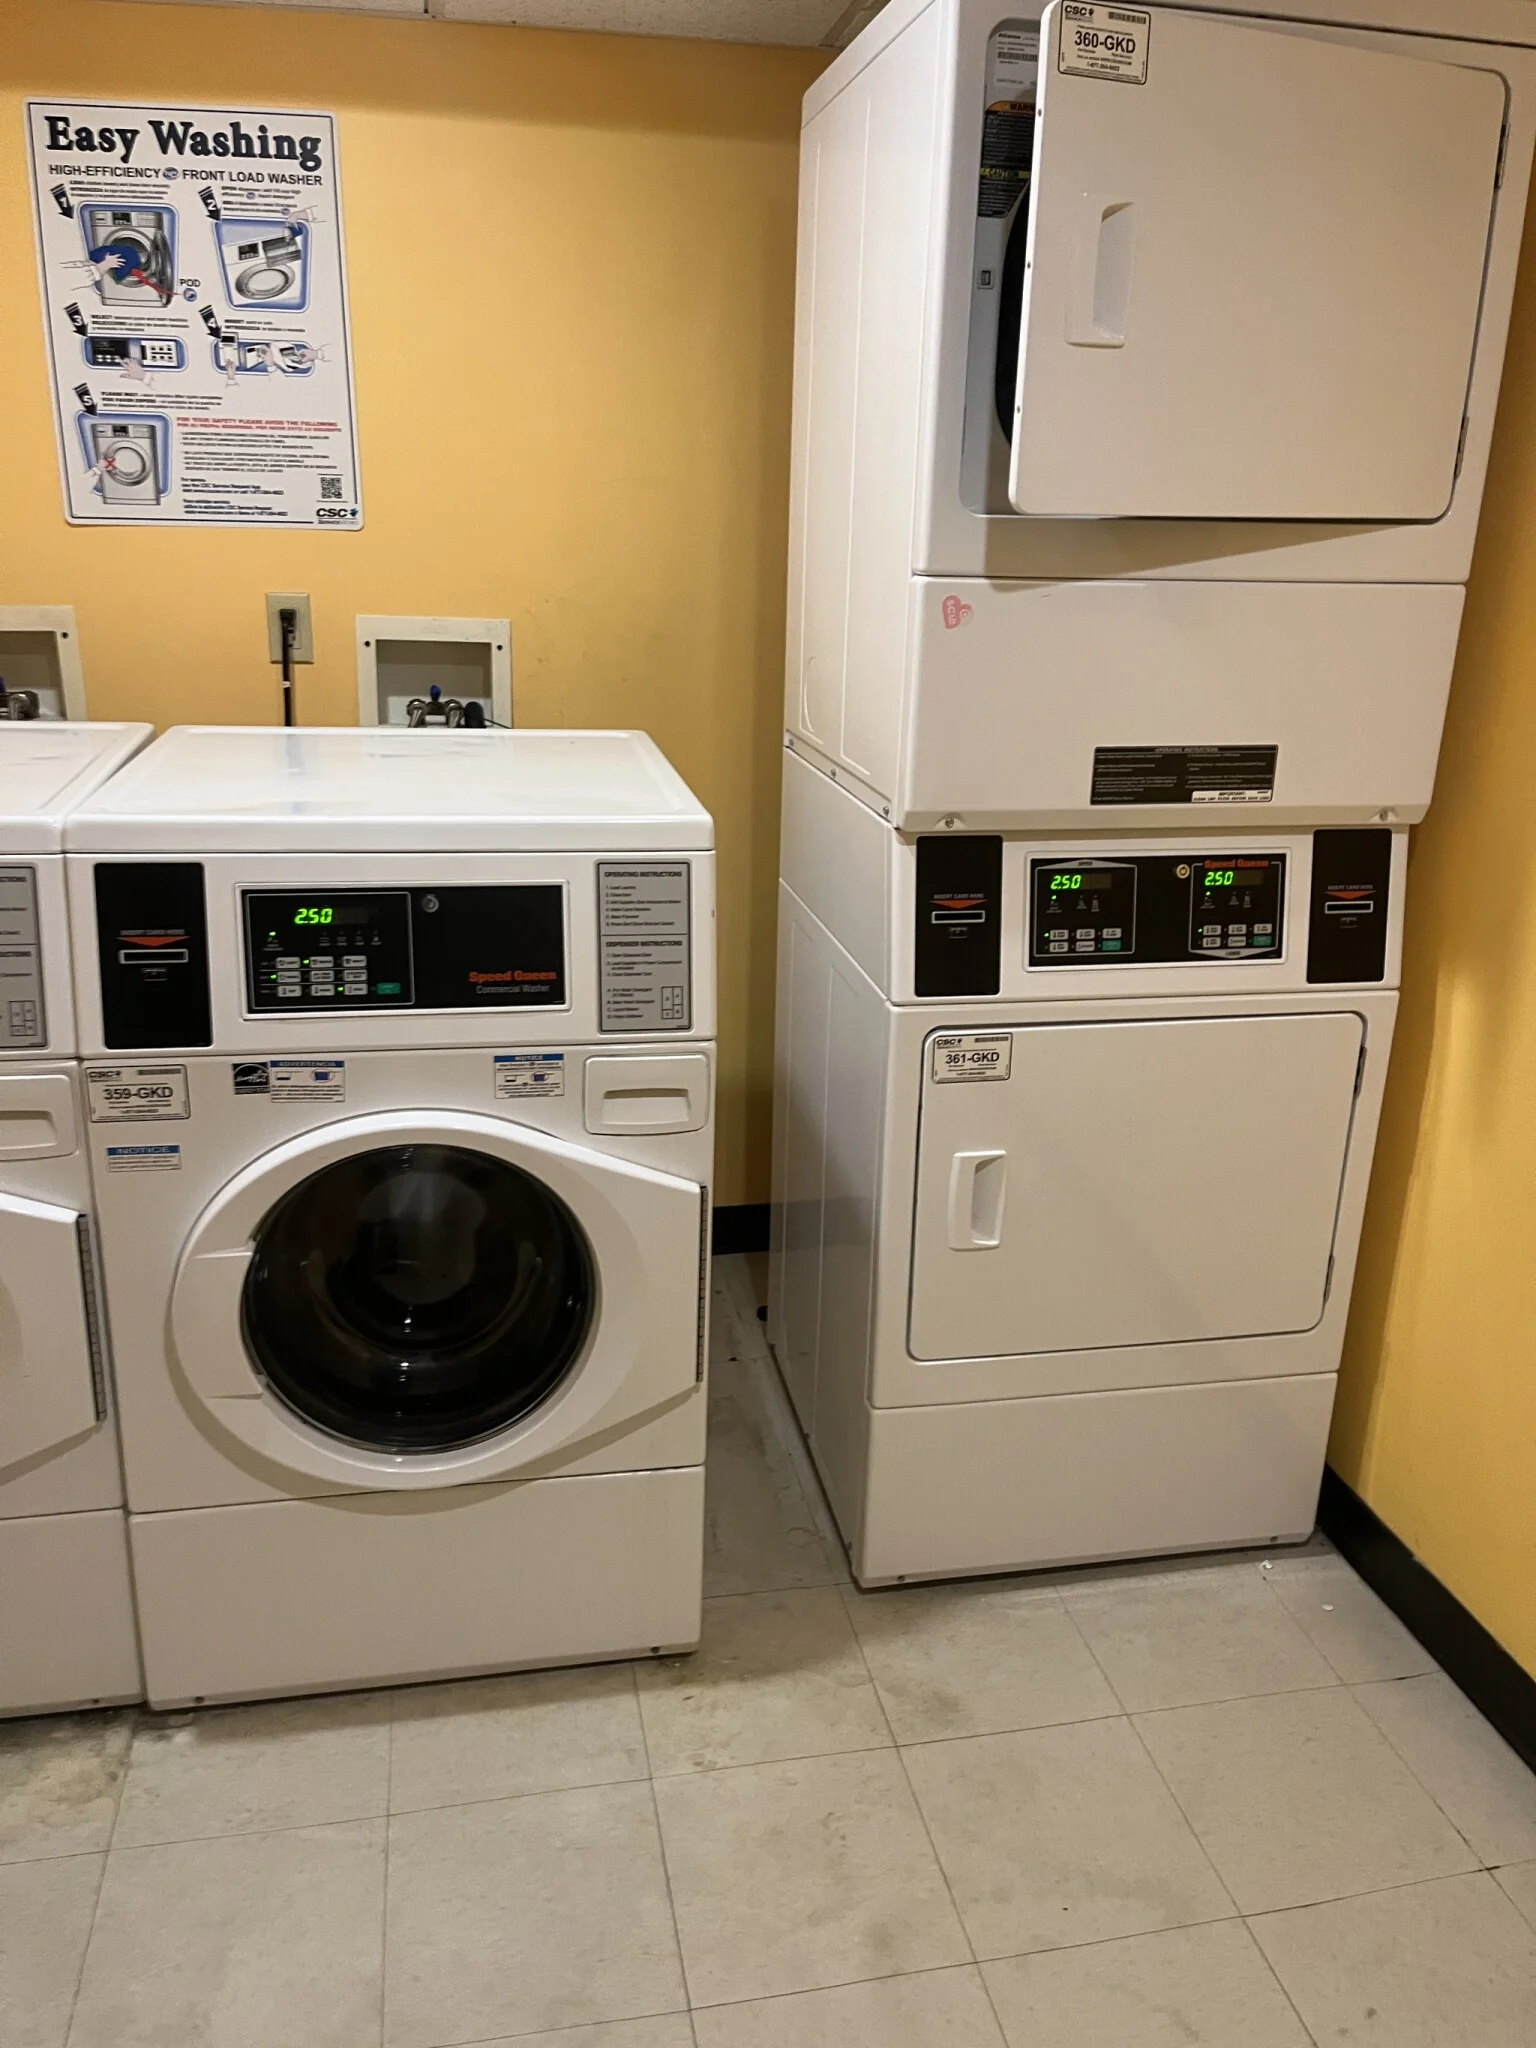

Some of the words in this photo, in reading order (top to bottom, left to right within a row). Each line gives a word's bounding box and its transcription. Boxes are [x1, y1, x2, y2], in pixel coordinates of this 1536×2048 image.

[1064, 5, 1087, 16] CSC
[1074, 30, 1136, 53] 360-GKD
[44, 116, 140, 164] Easy
[148, 118, 322, 172] Washing
[49, 164, 161, 179] HIGH-EFFICIENCY
[183, 170, 225, 182] FRONT
[228, 171, 265, 184] LOAD
[268, 172, 322, 186] WASHER
[207, 200, 216, 210] 2
[180, 278, 201, 288] POD
[72, 315, 82, 326] 3
[207, 318, 216, 328] 4
[83, 396, 92, 406] 5
[316, 508, 348, 518] CSC
[1204, 859, 1235, 869] Speed
[1237, 859, 1269, 867] Queen
[1050, 874, 1081, 890] 2.50
[1204, 871, 1233, 886] 2.50
[469, 971, 512, 983] Speed
[514, 970, 557, 980] Queen
[945, 1052, 1000, 1064] 361-GKD
[103, 1086, 173, 1100] 359-GKD
